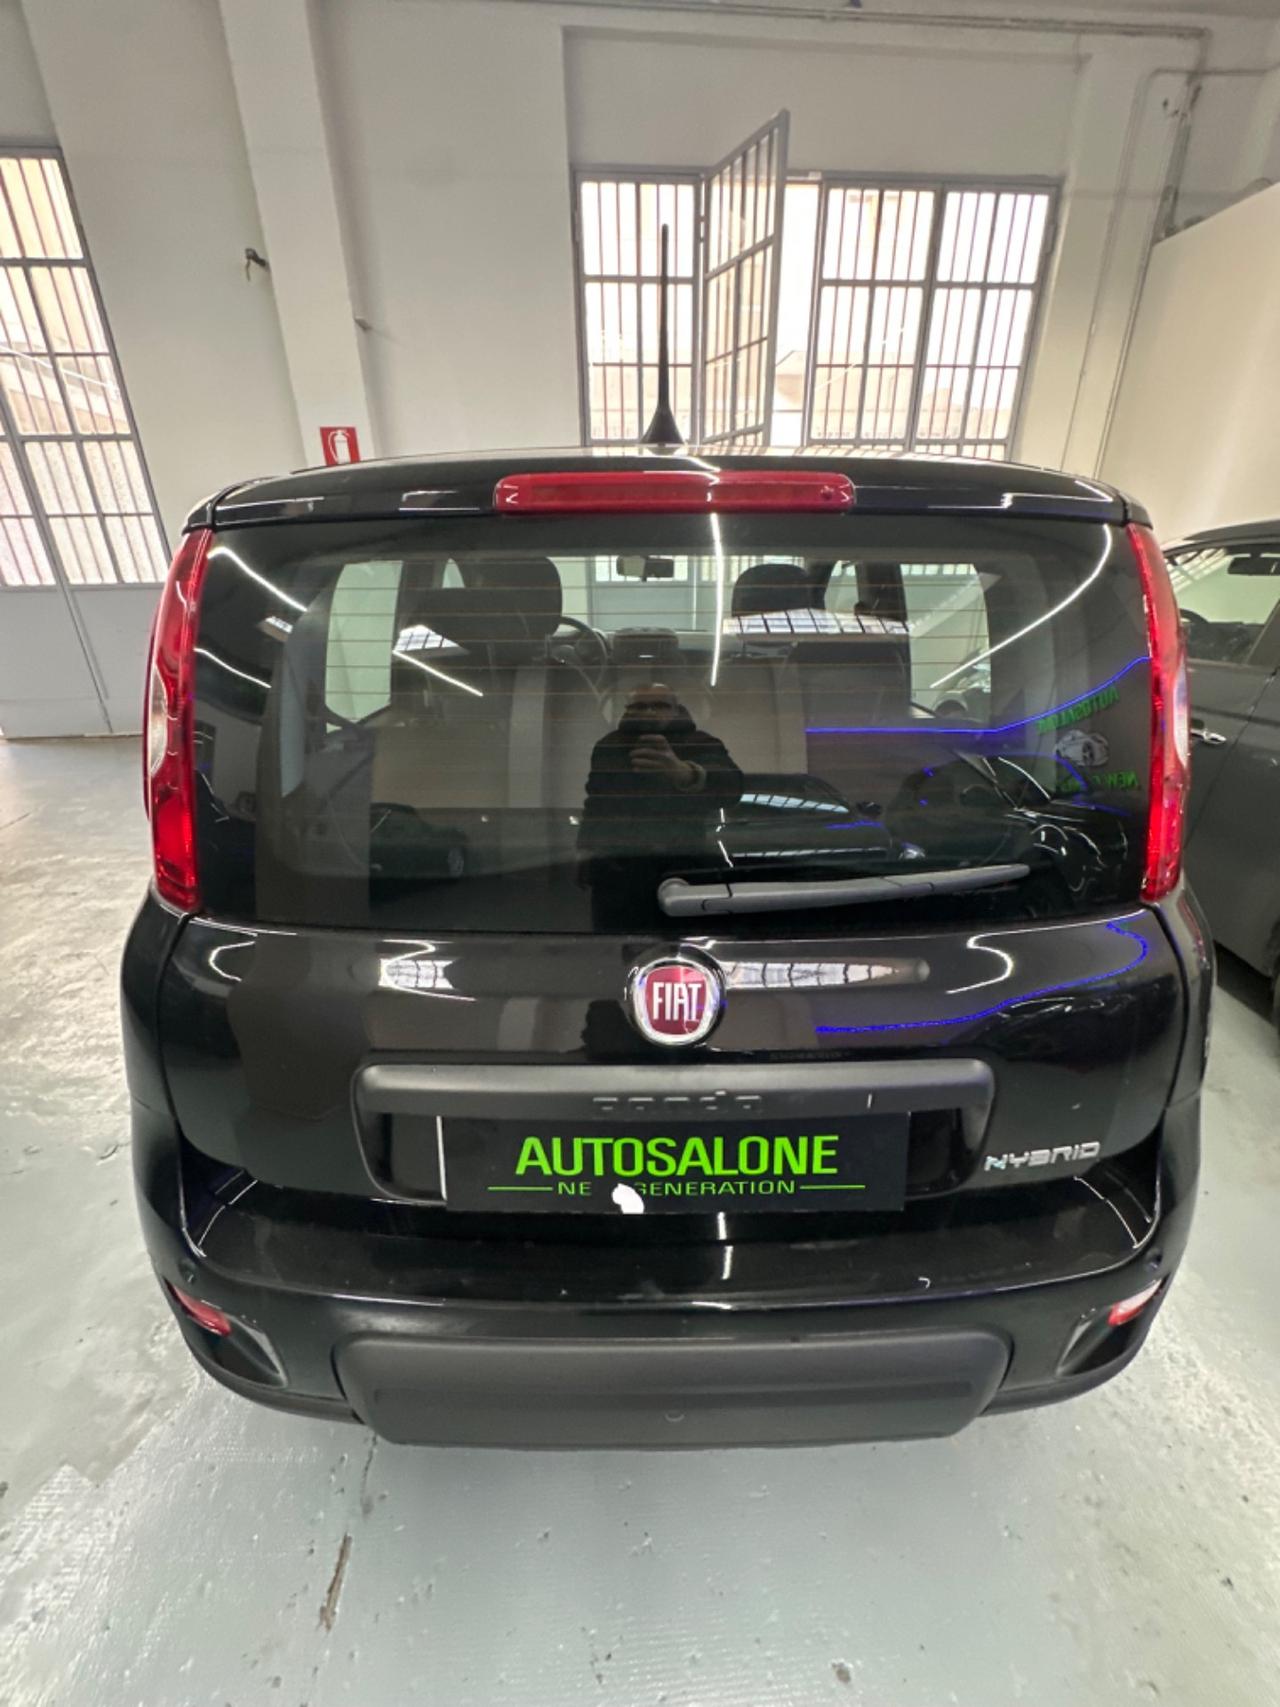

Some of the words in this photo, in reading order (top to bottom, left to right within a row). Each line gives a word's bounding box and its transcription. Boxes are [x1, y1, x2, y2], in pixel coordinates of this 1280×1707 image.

[653, 982, 702, 1021] FIAT
[515, 1135, 839, 1176] AUTOSALONE
[984, 1142, 1100, 1171] HYBRID
